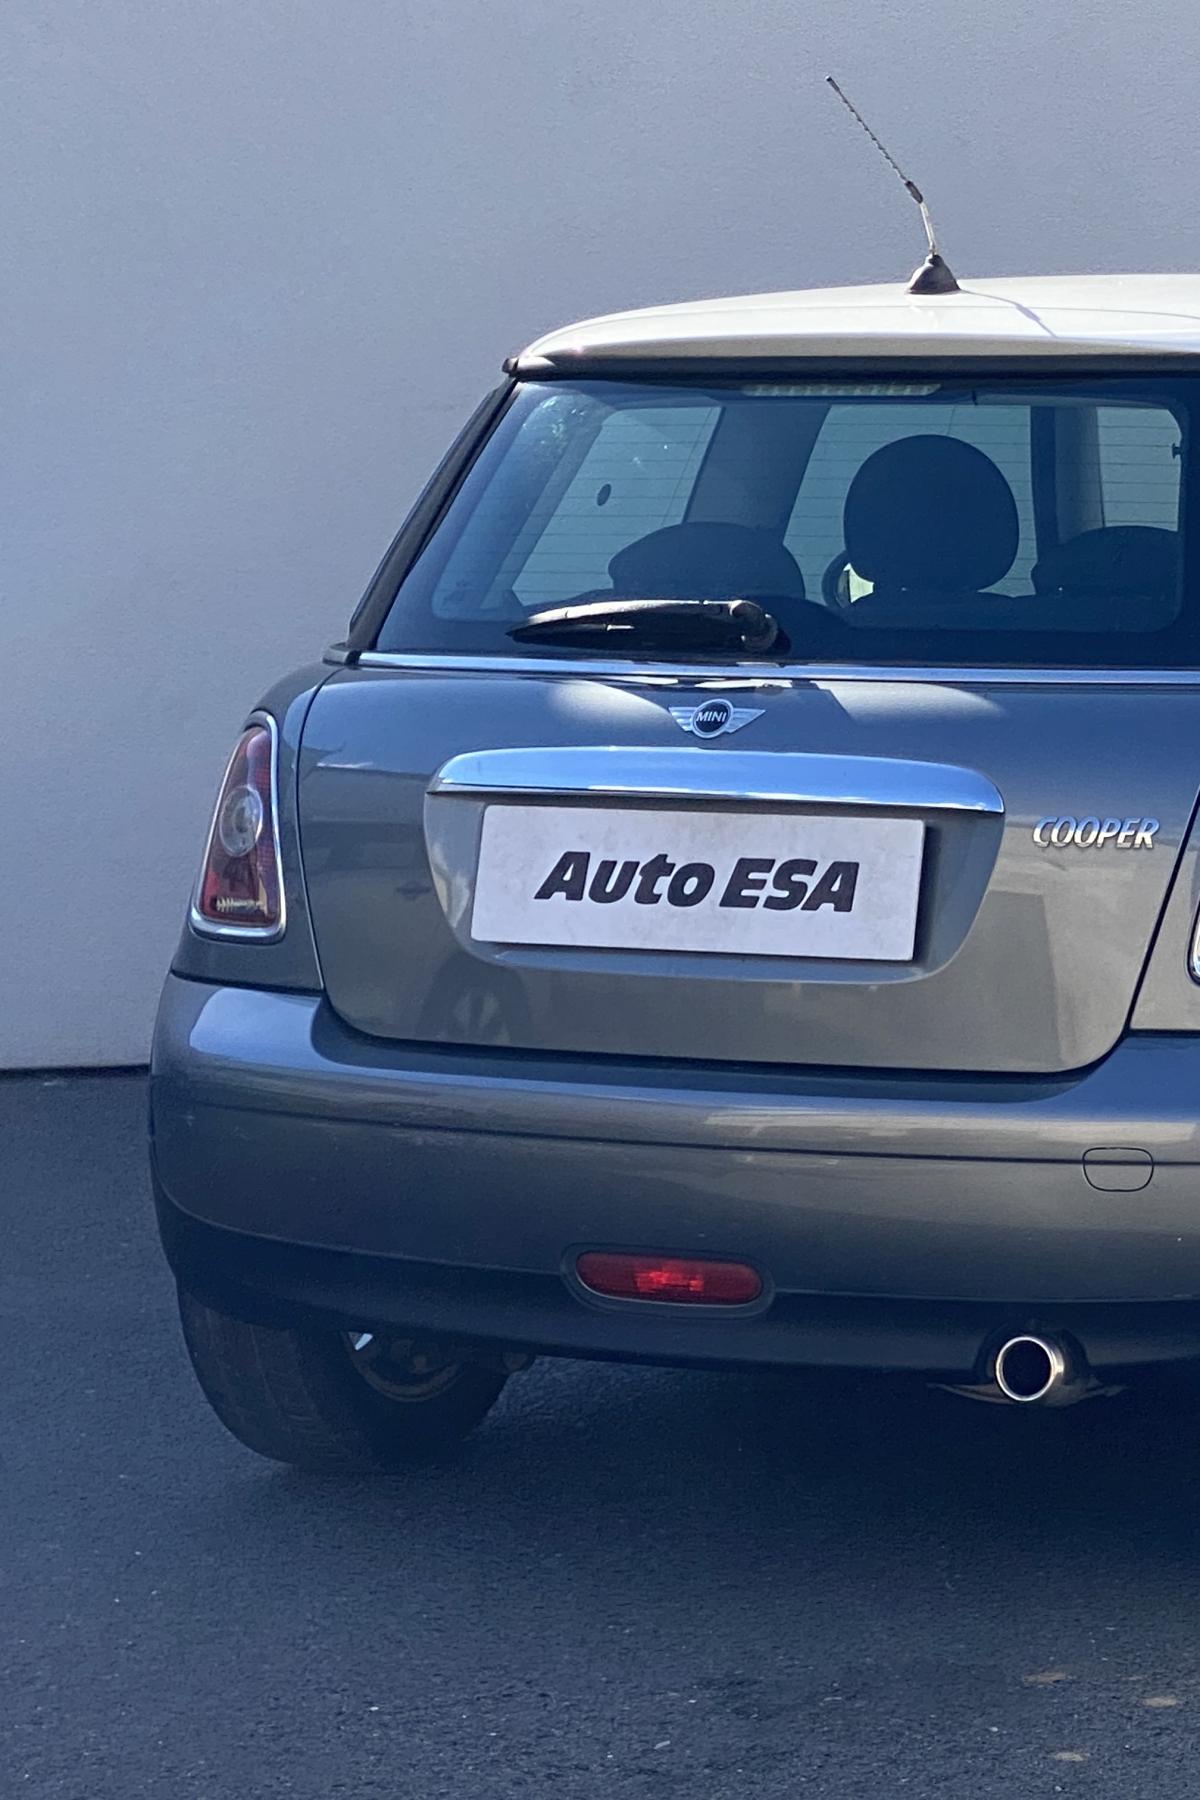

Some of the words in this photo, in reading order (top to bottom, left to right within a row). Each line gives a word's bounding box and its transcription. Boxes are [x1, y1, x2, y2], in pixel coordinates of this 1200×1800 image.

[696, 711, 727, 722] MINI
[1032, 815, 1160, 849] COOPER
[535, 851, 715, 909] Auto
[719, 857, 860, 913] ESA
